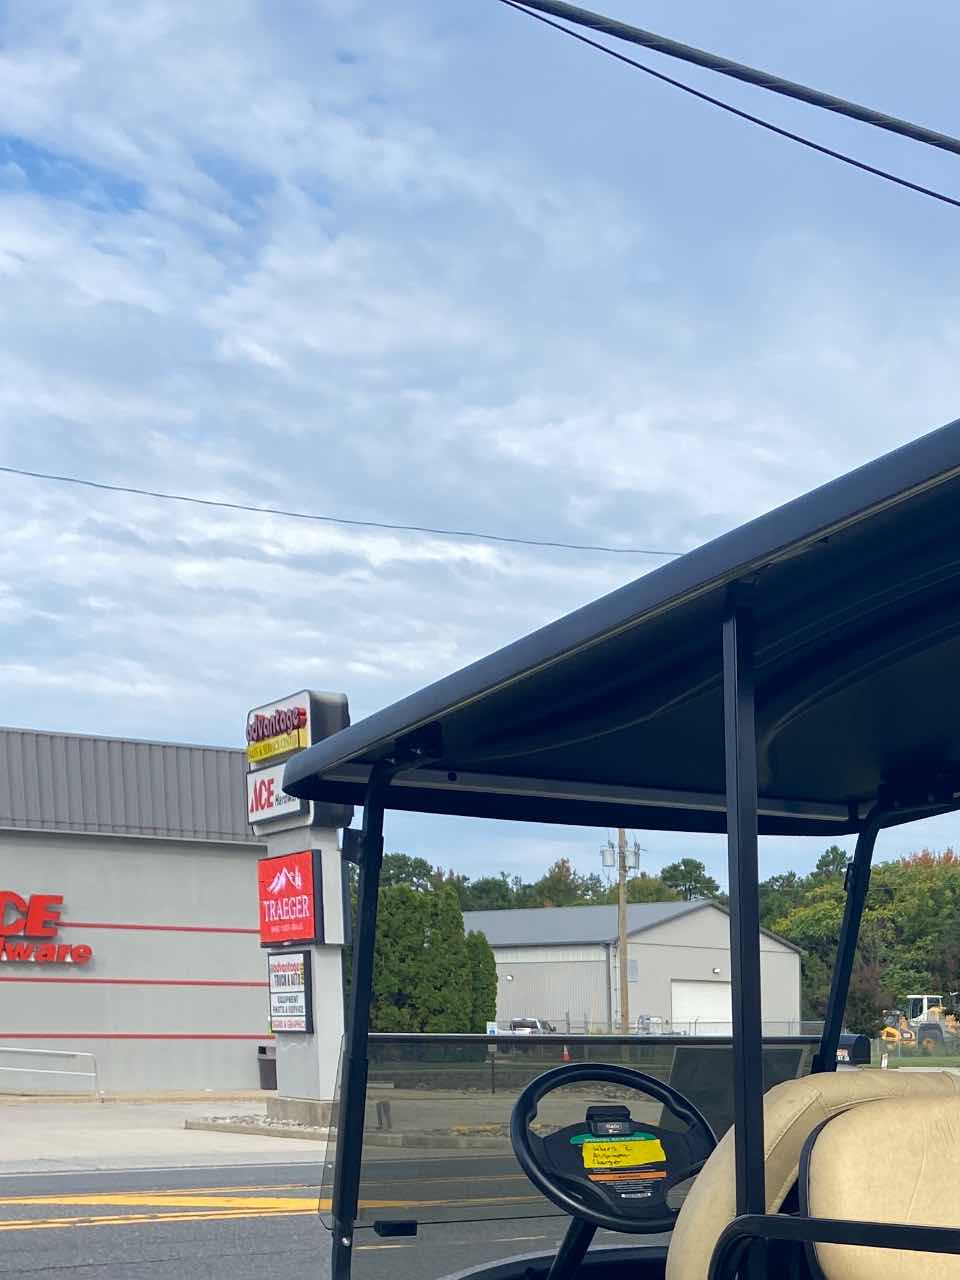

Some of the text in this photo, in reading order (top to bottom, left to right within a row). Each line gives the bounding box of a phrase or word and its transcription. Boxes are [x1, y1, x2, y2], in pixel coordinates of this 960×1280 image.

[250, 778, 274, 813] ACE
[0, 890, 64, 937] CE
[264, 894, 310, 922] TRAEGER
